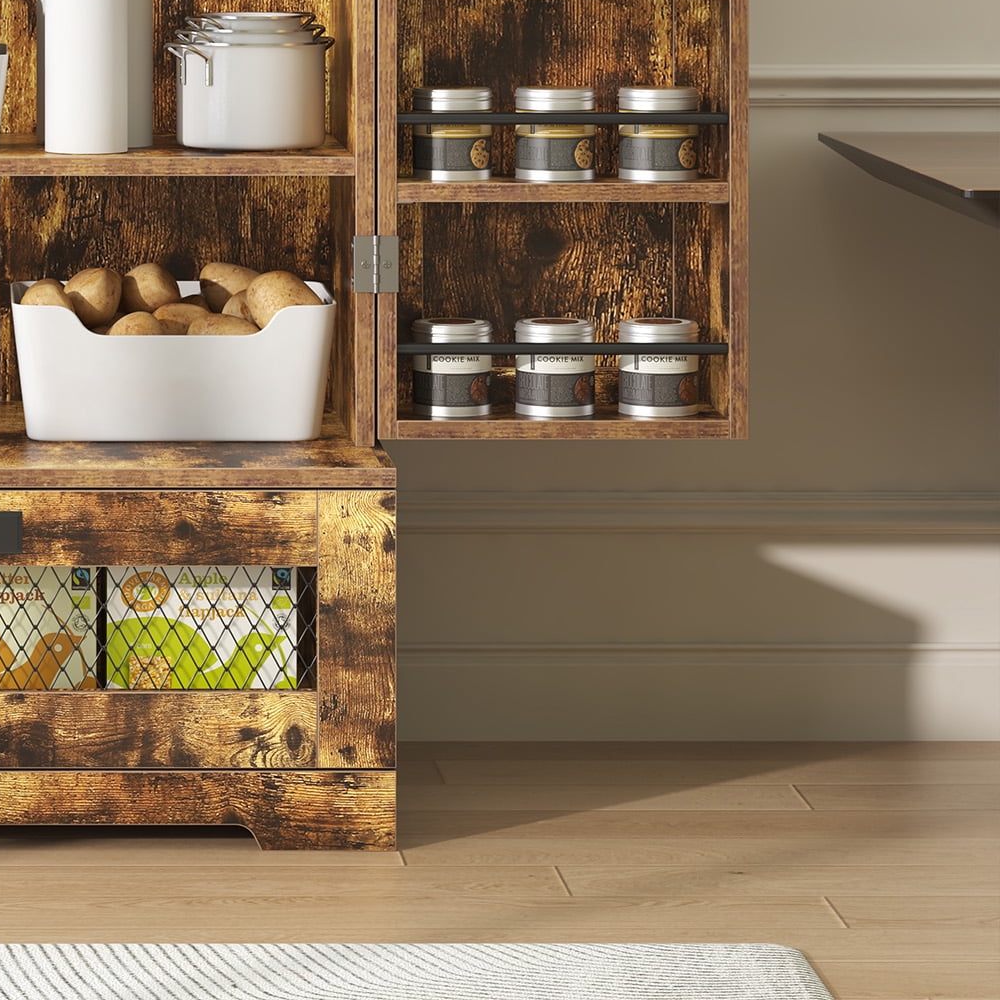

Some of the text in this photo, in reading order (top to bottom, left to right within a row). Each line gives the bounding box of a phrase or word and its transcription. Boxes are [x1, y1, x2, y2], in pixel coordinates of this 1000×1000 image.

[433, 355, 480, 363] COOKIE MIX
[537, 355, 584, 363] COOKIE MIX
[641, 355, 688, 363] COOKIE MIX
[178, 571, 229, 588] Apple
[180, 588, 259, 601] & sultana
[178, 605, 246, 621] flapjack
